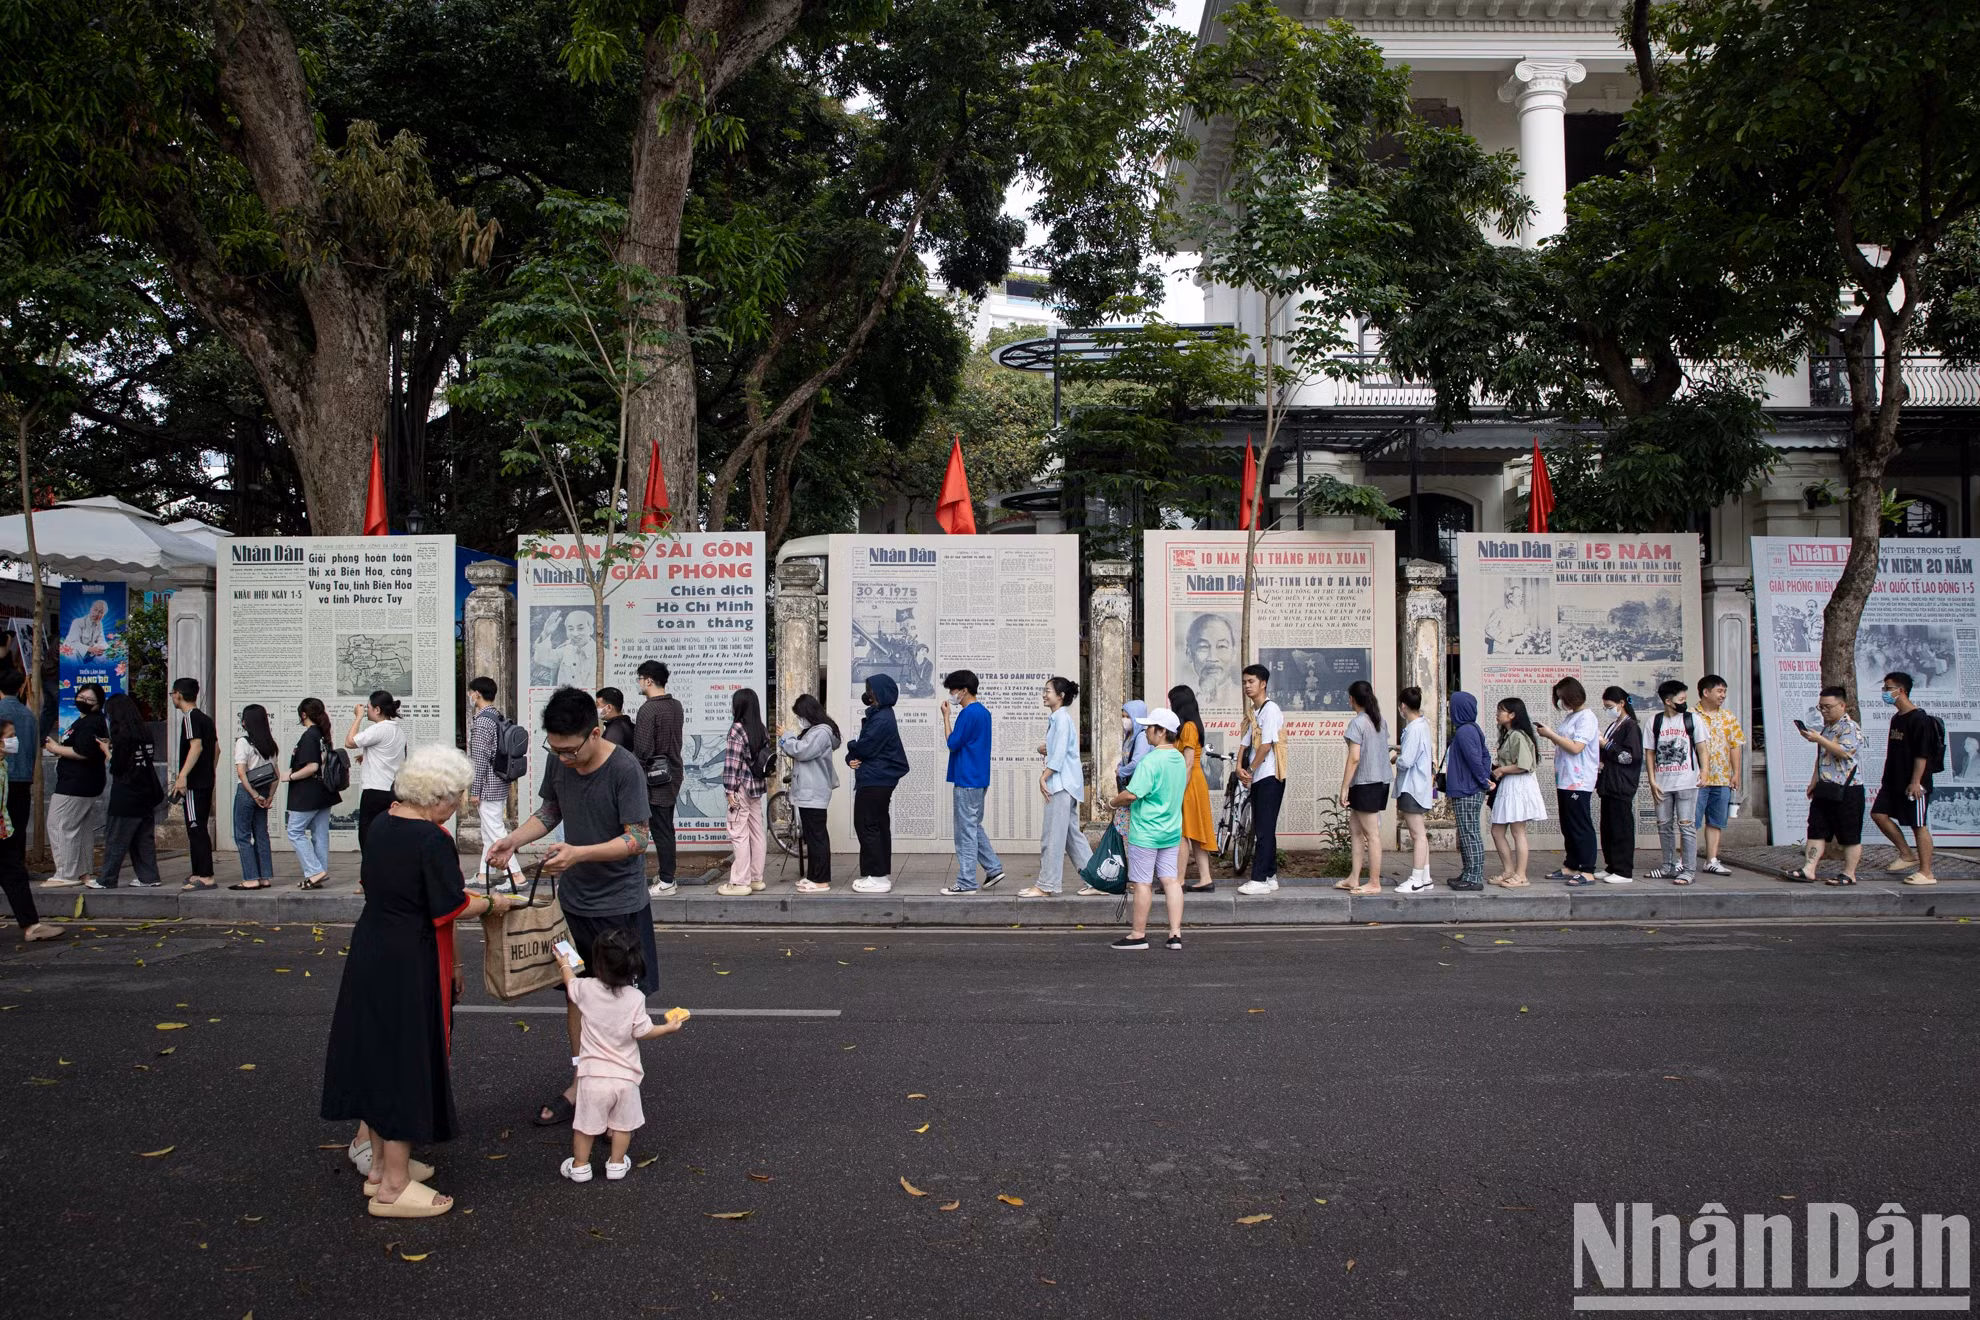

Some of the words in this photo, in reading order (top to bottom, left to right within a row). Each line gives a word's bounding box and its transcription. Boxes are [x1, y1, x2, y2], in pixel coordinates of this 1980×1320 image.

[232, 544, 271, 562] Nhân
[274, 544, 304, 562] Dân
[655, 540, 692, 558] SÀI
[702, 540, 753, 557] GÒN
[869, 547, 906, 563] Nhân
[909, 547, 937, 563] Dân
[1478, 540, 1519, 558] Nhân
[1521, 540, 1552, 558] Dân
[1586, 543, 1612, 560] 15
[1618, 541, 1672, 560] NĂM
[1791, 545, 1833, 562] Nhân
[1880, 546, 1915, 554] MÍT-TINH
[1916, 547, 1944, 555] TRỌNG
[308, 553, 326, 563] Giải
[331, 553, 359, 564] phóng
[365, 553, 387, 563] hoàn
[392, 553, 412, 562] toàn
[1201, 552, 1212, 564] 10
[1336, 551, 1366, 565] XUÂN
[308, 567, 320, 578] thị
[341, 567, 361, 577] Biên
[365, 567, 386, 578] Hòa,
[611, 561, 658, 580] GIẢI
[668, 561, 752, 579] PHÓNG
[1556, 560, 1573, 570] NGÀY
[1603, 561, 1616, 570] LỢI
[1663, 561, 1682, 571] CUỘC
[1891, 556, 1923, 575] NIỆM
[1926, 559, 1942, 574] 20
[1945, 556, 1973, 574] NĂM
[1186, 574, 1224, 591] Nhân
[1305, 575, 1323, 587] LỚN
[1327, 574, 1334, 586] Ở
[1338, 575, 1351, 587] HÀ
[1355, 575, 1372, 588] NỘI
[1581, 573, 1602, 583] CHIẾN
[1663, 573, 1682, 583] NƯỚC
[1769, 577, 1785, 592] GIẢI
[1786, 577, 1813, 593] PHÓNG
[1815, 577, 1833, 593] MIỀN
[308, 581, 331, 592] Vũng
[333, 581, 352, 592] Tàu,
[372, 580, 392, 590] Biên
[394, 580, 412, 590] Hòa
[671, 584, 716, 596] Chiến
[720, 585, 754, 597] dịch
[1889, 578, 1910, 593] QUỐC
[1911, 578, 1921, 593] TẾ
[1921, 582, 1936, 593] LAO
[1938, 579, 1960, 595] ĐỘNG
[1962, 581, 1975, 593] 1-5
[291, 590, 302, 599] 1-5
[319, 595, 329, 604] và
[353, 594, 383, 604] Phước
[387, 593, 403, 605] Tuy
[656, 601, 679, 613] Hồ
[716, 601, 753, 612] Minh
[657, 618, 696, 629] toàn
[707, 617, 754, 631] thắng
[511, 941, 539, 960] HELLO
